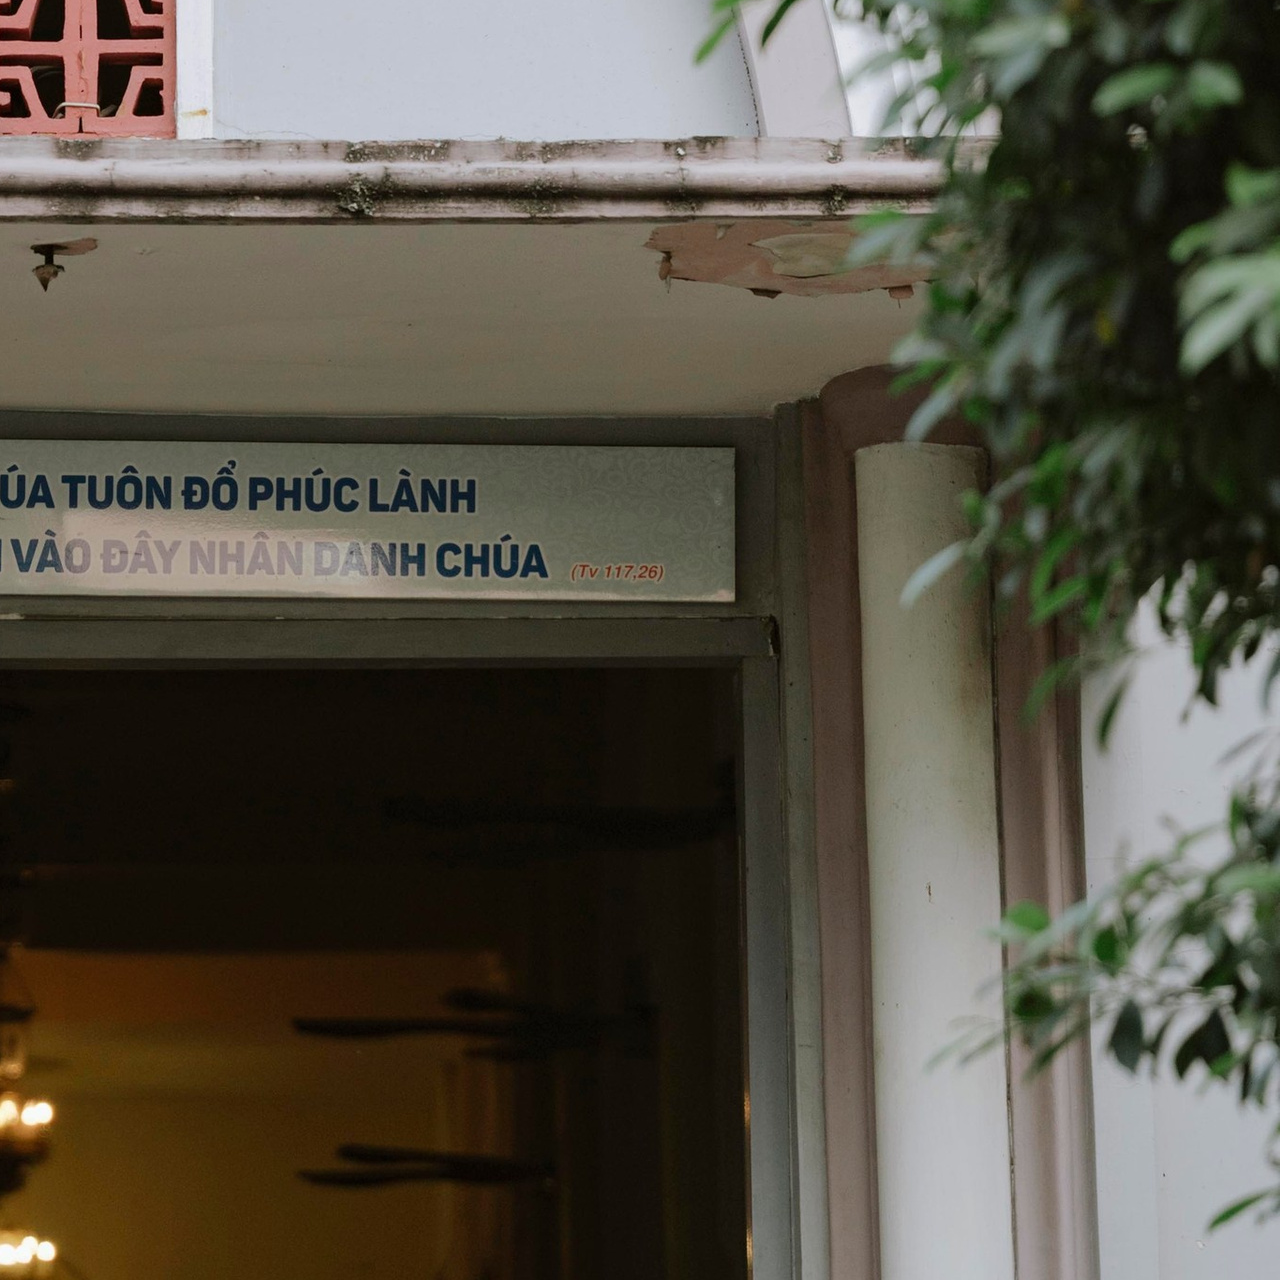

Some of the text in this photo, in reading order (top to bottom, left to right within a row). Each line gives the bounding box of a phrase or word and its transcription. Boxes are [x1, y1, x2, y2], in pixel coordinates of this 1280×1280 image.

[61, 465, 172, 510] TUÔN
[181, 460, 239, 511] ĐỔ
[248, 468, 359, 512] PHÚC
[369, 468, 476, 513] LÀNH
[10, 529, 91, 573] VÀO
[100, 530, 182, 574] ĐÂY
[189, 531, 303, 576] NHÂN
[314, 541, 426, 577] DANH
[436, 534, 549, 578] CHÚA
[571, 564, 664, 581] (Tv 117,26)
